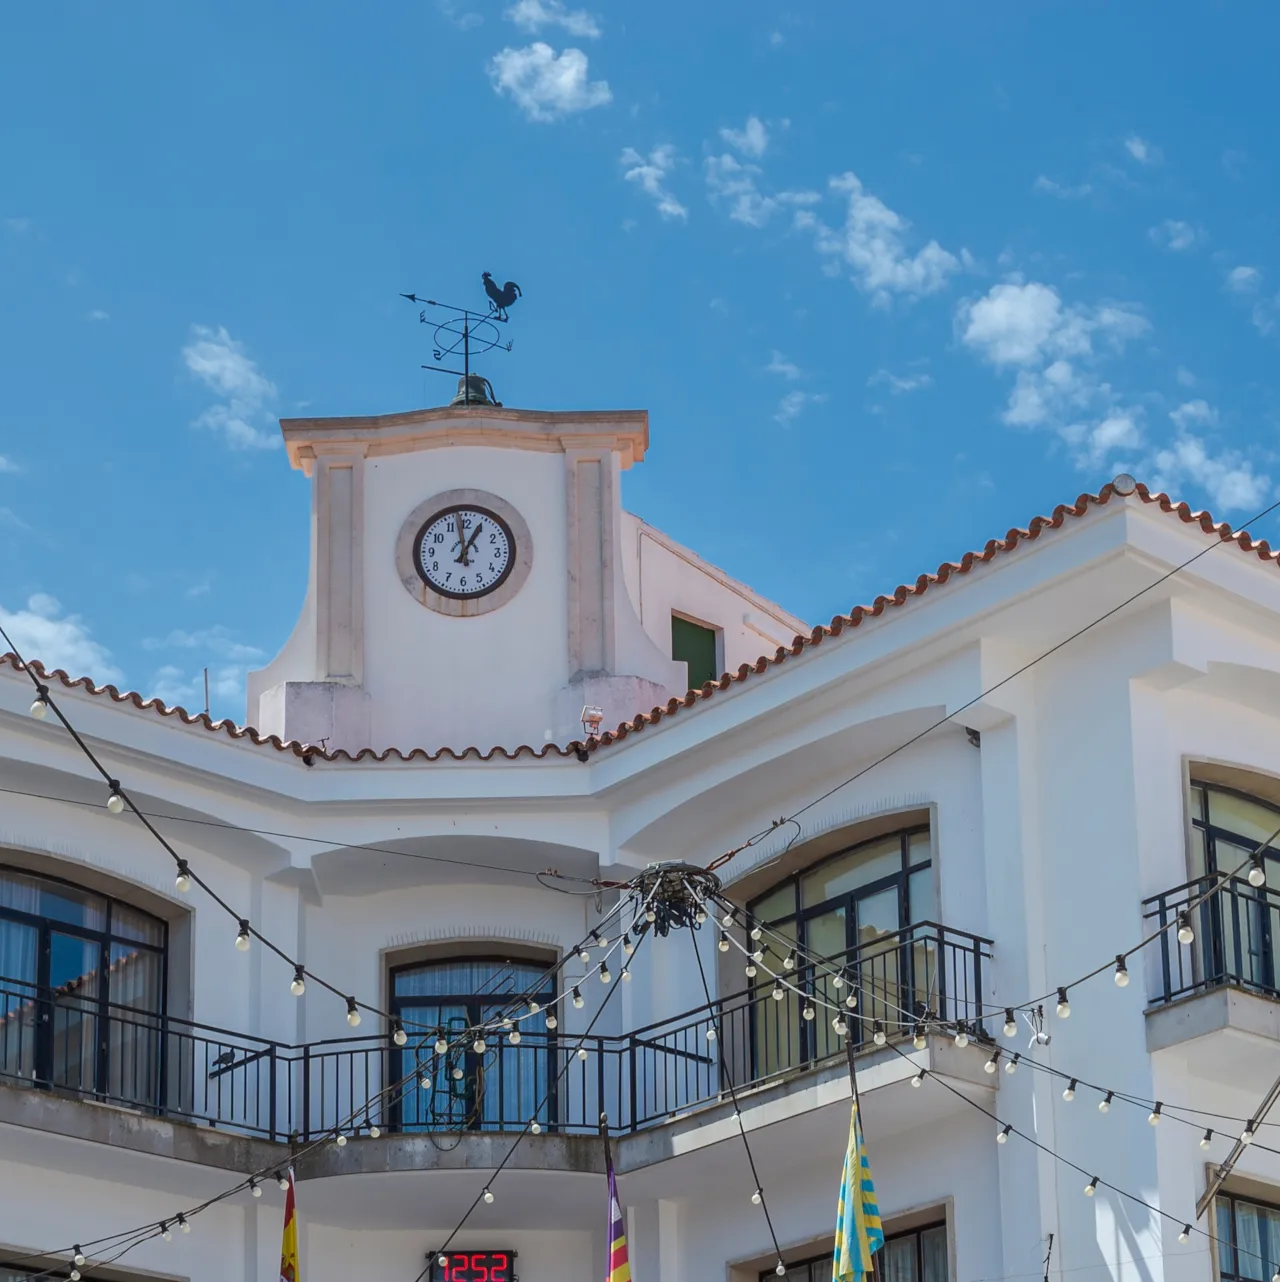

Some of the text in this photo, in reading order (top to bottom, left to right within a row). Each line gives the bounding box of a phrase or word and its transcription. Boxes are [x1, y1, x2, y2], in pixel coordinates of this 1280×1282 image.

[446, 522, 455, 532] 11
[433, 533, 444, 543] 10
[489, 533, 497, 544] 2
[428, 547, 435, 557] 9
[493, 547, 501, 558] 3
[432, 561, 439, 571] 8
[488, 562, 495, 572] 4
[445, 572, 453, 582] 7
[459, 576, 467, 587] 6
[475, 573, 483, 583] 5
